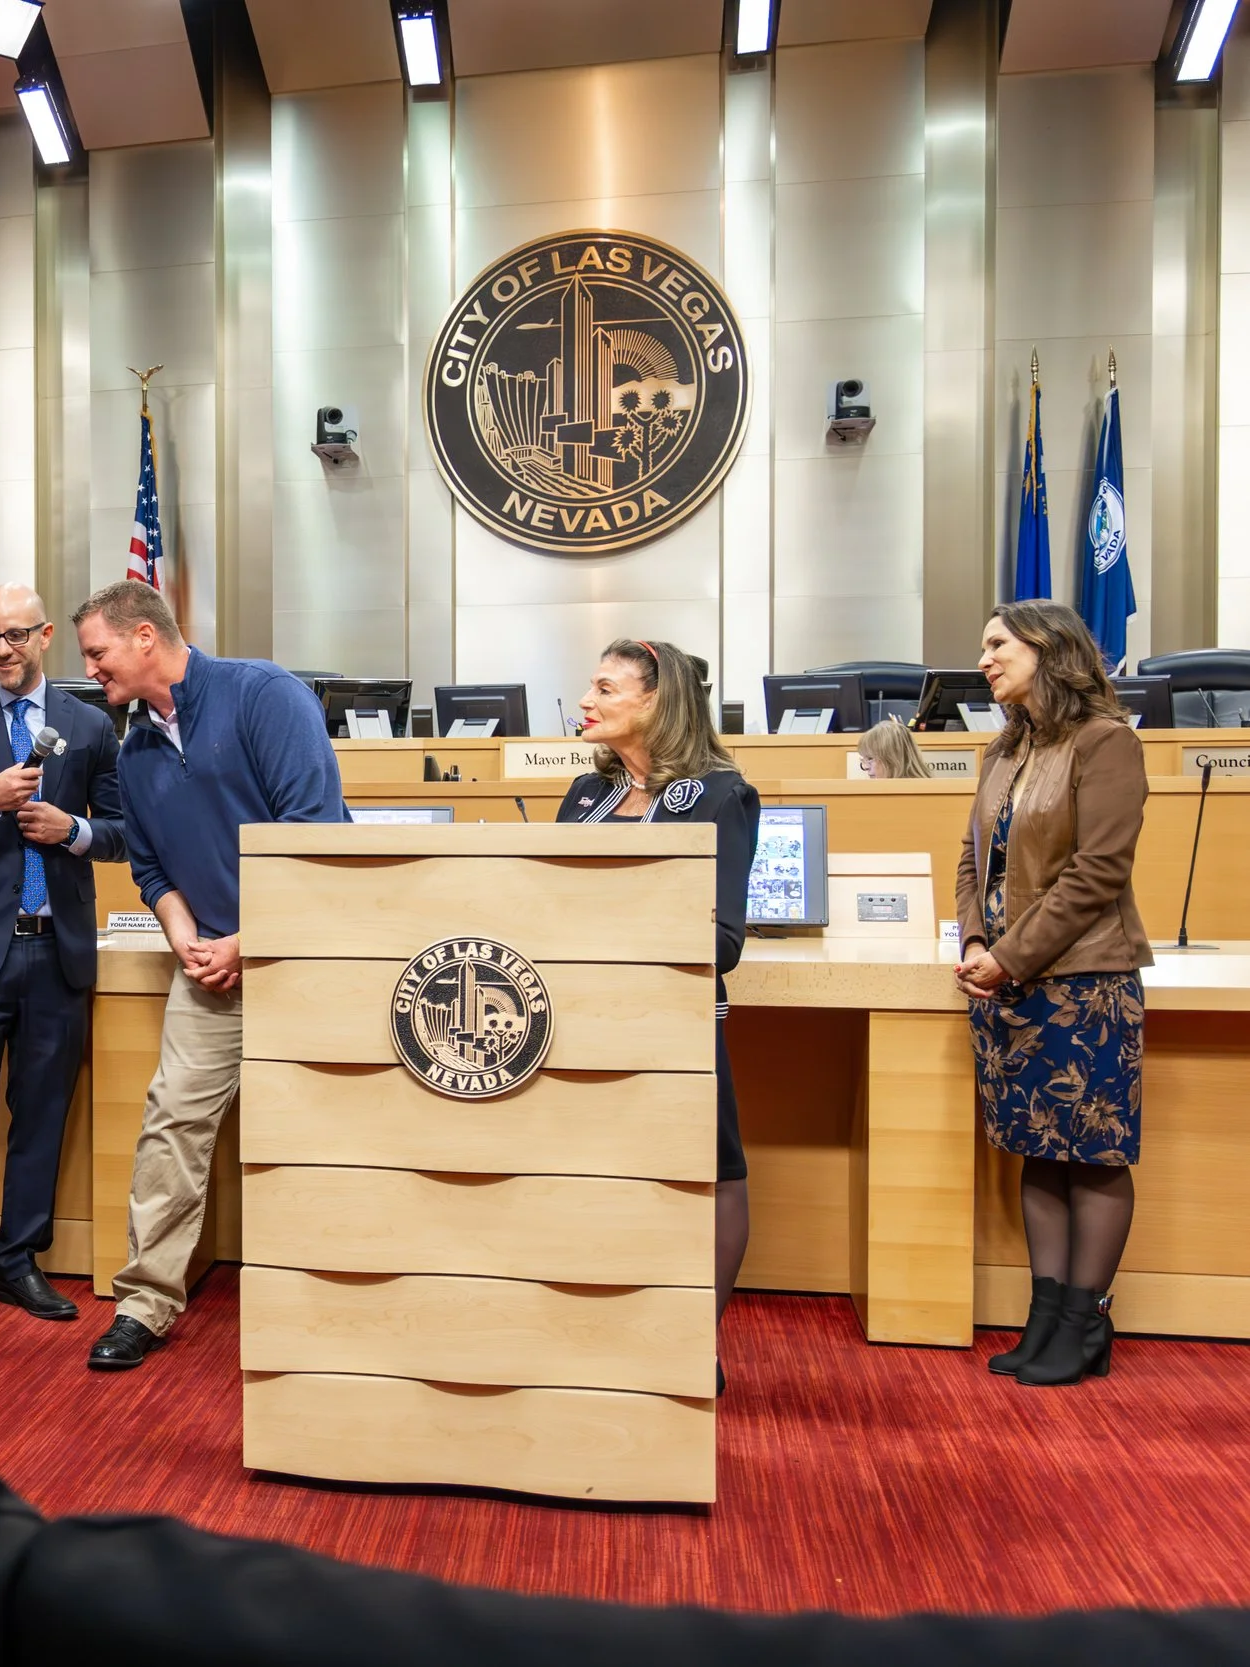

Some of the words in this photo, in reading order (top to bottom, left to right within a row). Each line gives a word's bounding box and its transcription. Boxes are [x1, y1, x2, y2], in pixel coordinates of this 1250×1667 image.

[441, 300, 490, 388] CITY
[491, 258, 543, 303] OF
[551, 246, 633, 275] LAS
[641, 254, 734, 374] VEGAS
[502, 488, 670, 534] NEVADA
[1100, 529, 1121, 563] VADA
[525, 753, 566, 767] Mayor
[570, 752, 594, 765] Ber
[927, 761, 967, 771] oman
[395, 970, 422, 1014] CITY
[422, 947, 447, 971] OF
[453, 943, 493, 960] LAS
[500, 952, 546, 1014] VEGAS
[425, 1063, 514, 1091] NEVADA
